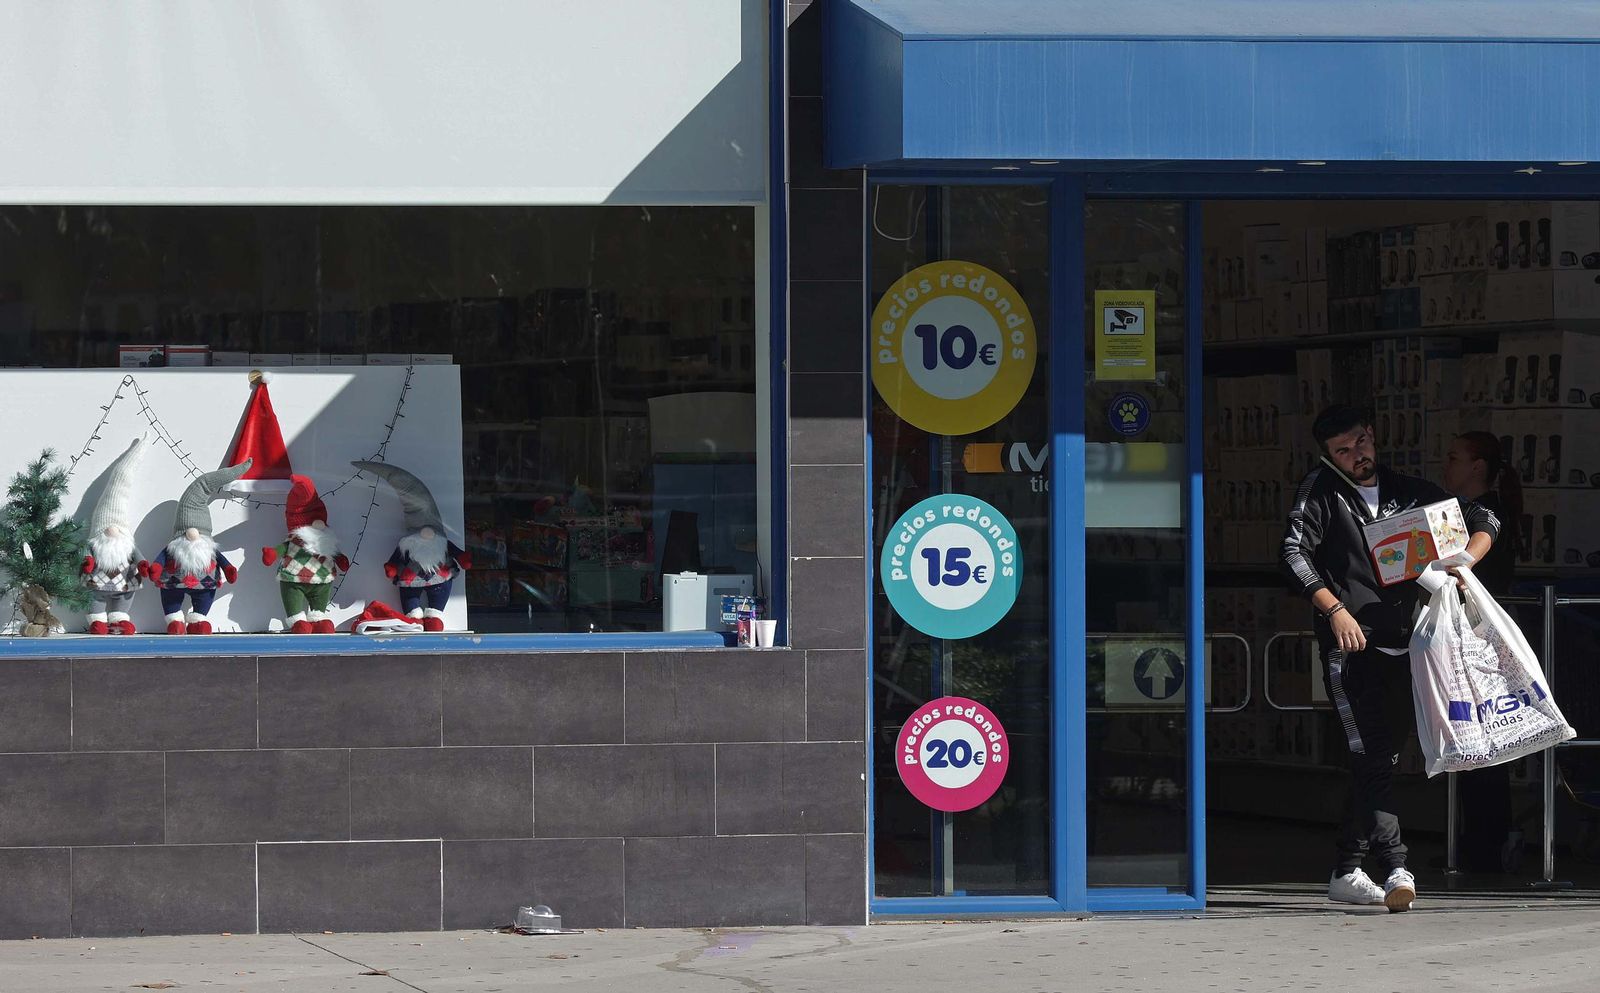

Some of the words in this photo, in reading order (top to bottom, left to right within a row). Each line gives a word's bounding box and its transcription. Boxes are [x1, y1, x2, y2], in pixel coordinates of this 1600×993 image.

[877, 273, 933, 365] precios
[940, 273, 1026, 362] redondos
[913, 323, 998, 371] 10€
[891, 507, 936, 582] precios
[941, 504, 1014, 578] redondos
[921, 546, 988, 588] 15€
[904, 706, 941, 766] precios
[945, 704, 1003, 764] redondos
[925, 738, 985, 769] 20€
